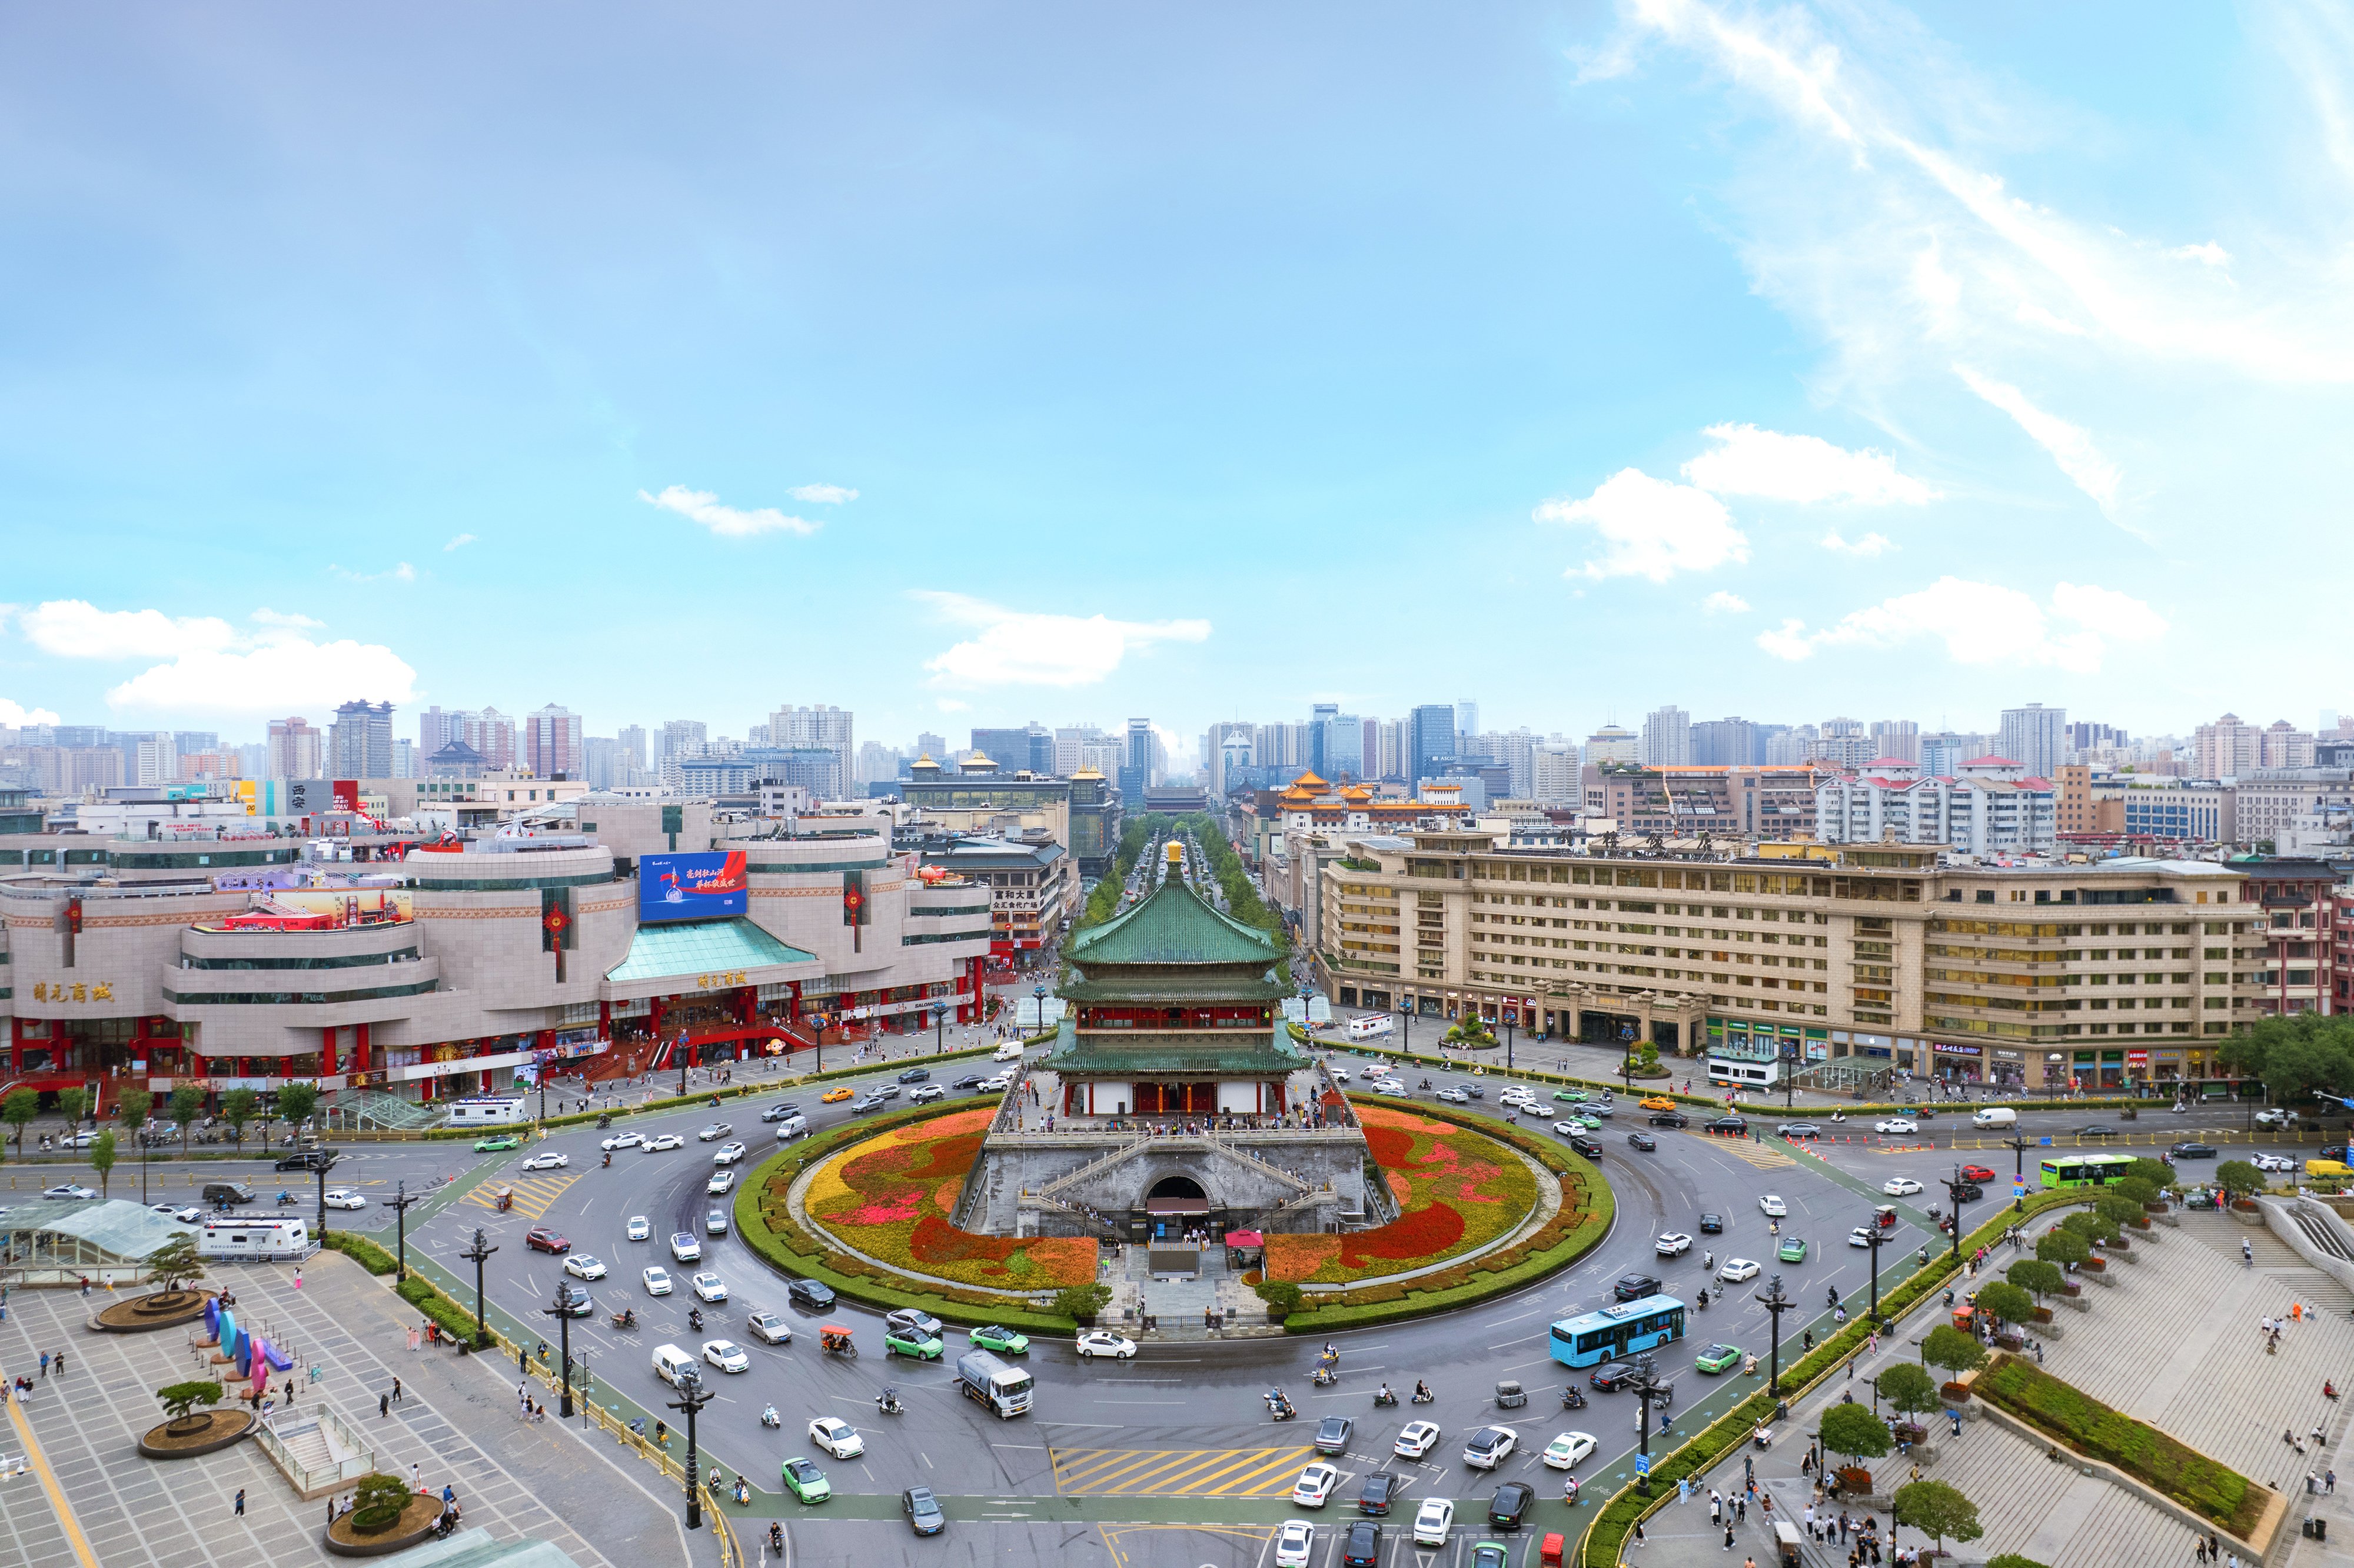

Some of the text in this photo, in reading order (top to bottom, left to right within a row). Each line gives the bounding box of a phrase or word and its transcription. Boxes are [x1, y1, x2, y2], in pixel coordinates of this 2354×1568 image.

[292, 785, 306, 809] 西安
[995, 890, 1036, 900] 富和大厦
